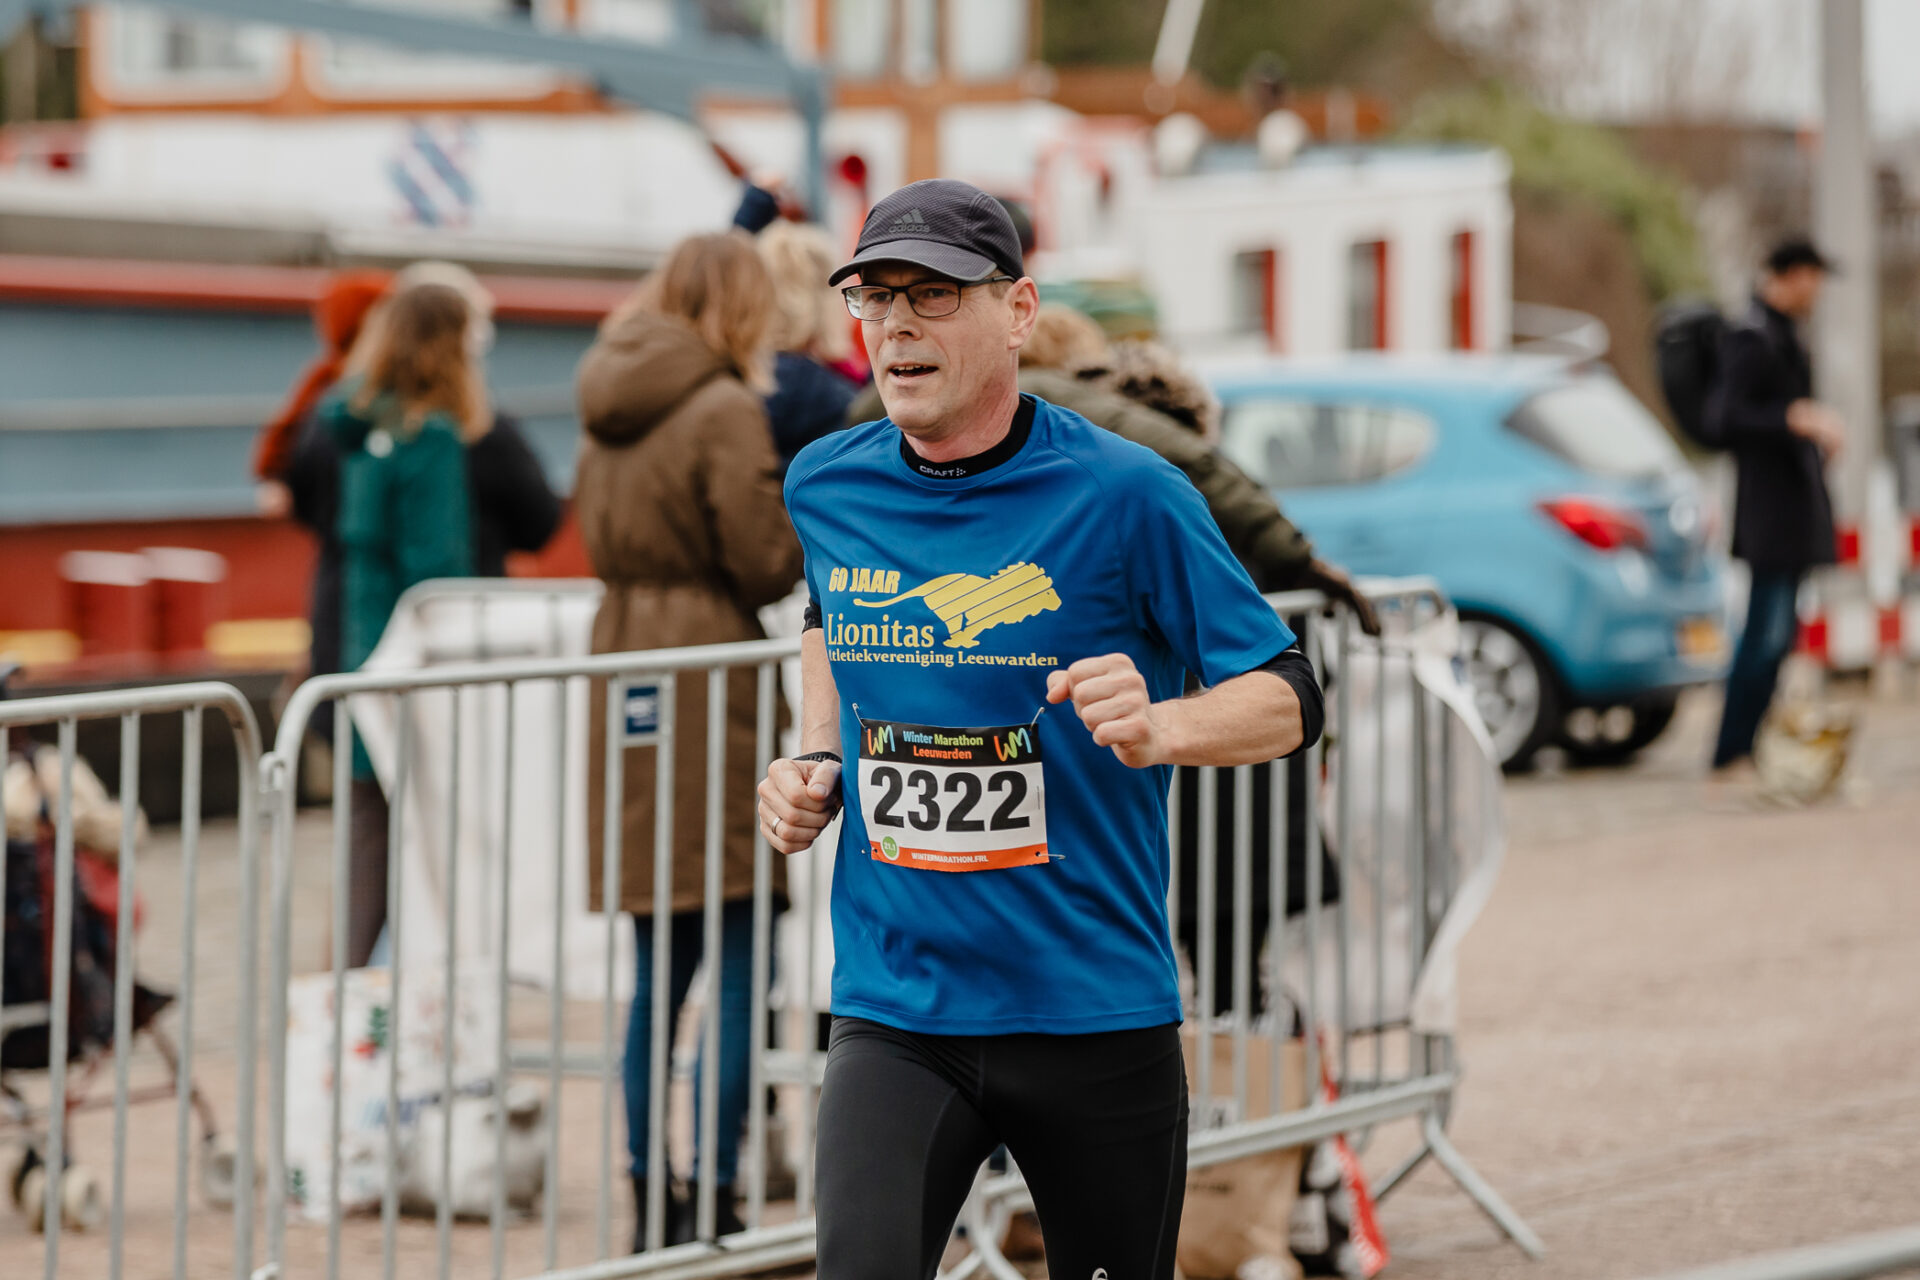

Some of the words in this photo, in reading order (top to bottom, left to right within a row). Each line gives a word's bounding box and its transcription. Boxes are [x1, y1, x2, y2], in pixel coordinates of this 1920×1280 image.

[888, 223, 930, 233] adidas
[919, 465, 954, 477] CRAFT
[828, 567, 848, 592] 60
[849, 568, 901, 594] JAAR
[827, 613, 934, 648] Lionitas
[958, 651, 1059, 667] Leeuwarden
[902, 730, 933, 745] Winter
[933, 733, 984, 746] Marathon
[912, 745, 973, 760] Leeuwarden
[870, 766, 1030, 832] 2322
[911, 852, 989, 864] WINTERMARATHON.FRL
